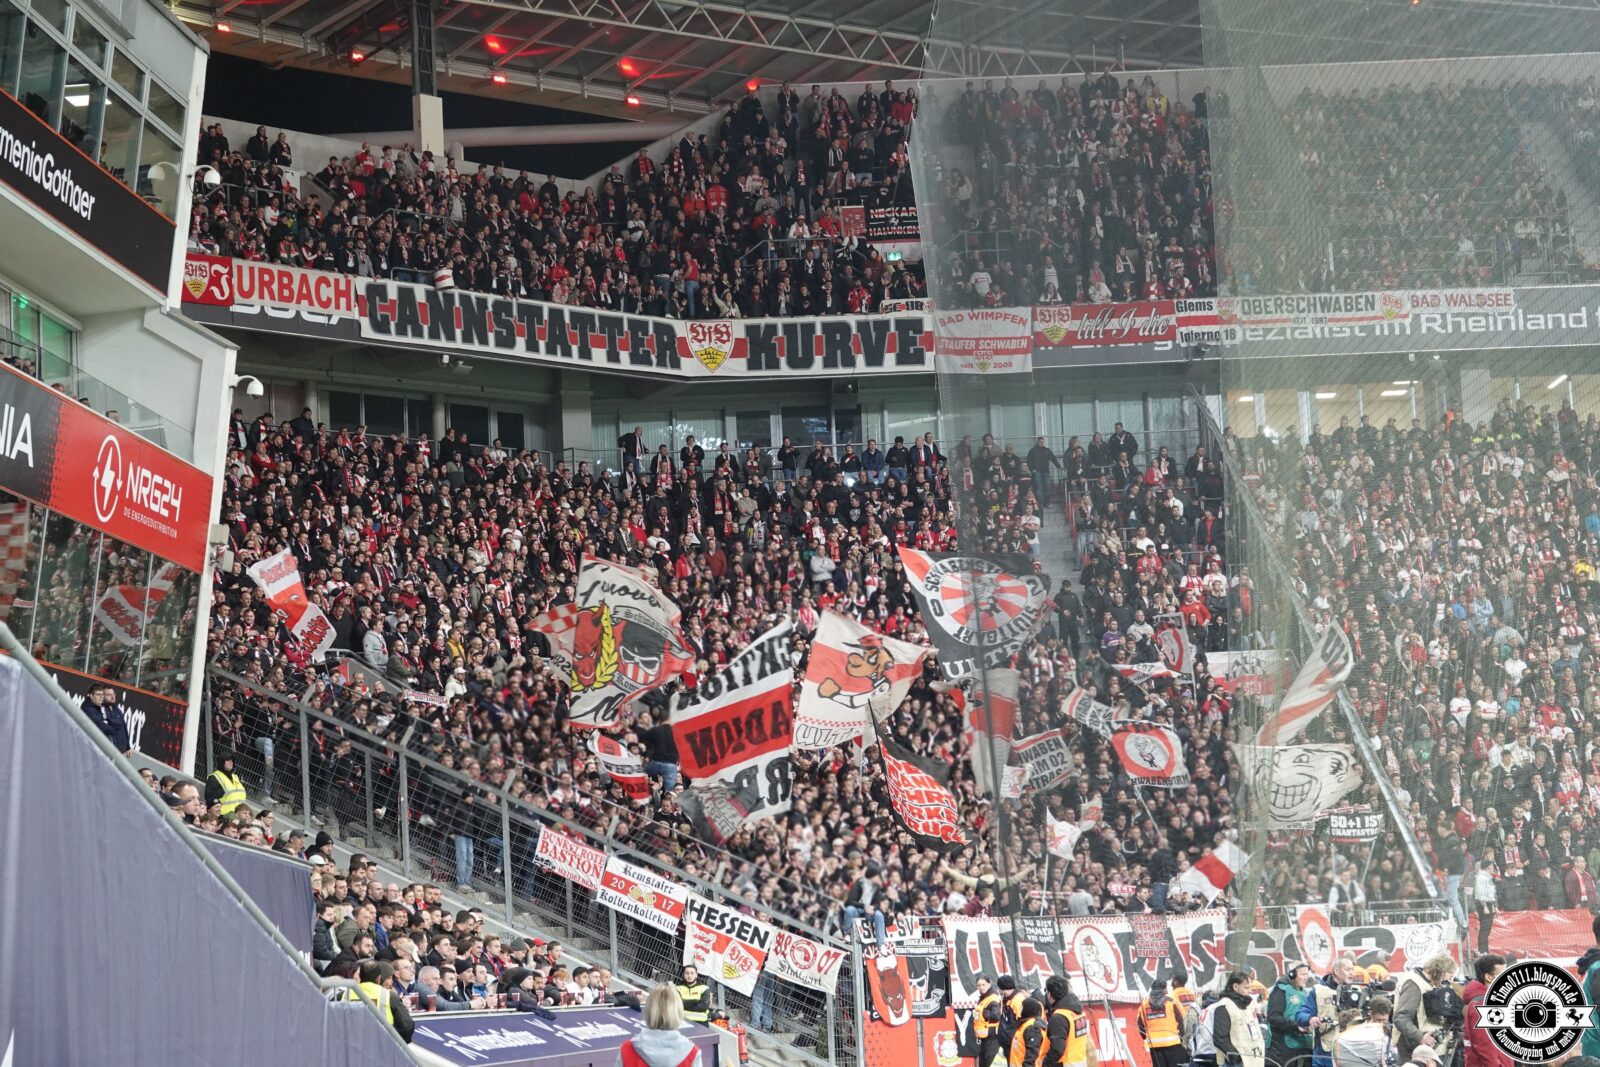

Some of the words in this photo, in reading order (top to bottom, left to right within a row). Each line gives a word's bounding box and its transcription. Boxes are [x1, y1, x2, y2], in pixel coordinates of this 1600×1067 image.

[0, 127, 95, 220] meniaGothaer
[870, 206, 918, 219] NECKAR
[237, 265, 353, 312] URBACH
[1410, 294, 1441, 309] BAD
[1444, 292, 1513, 308] WALDSEE
[938, 313, 964, 328] BAD
[967, 311, 1029, 328] WIMPFEN
[1175, 300, 1214, 313] Glems
[1241, 294, 1376, 316] OBERSCHWABEN
[1421, 306, 1588, 334] Rheinland
[364, 281, 682, 371] CANNSTATTER
[690, 322, 732, 346] VfB
[1077, 307, 1115, 340] till
[1139, 307, 1170, 337] die
[1180, 330, 1220, 343] Inferno
[1223, 328, 1237, 341] 18
[746, 318, 925, 371] KURVE
[940, 339, 976, 350] STAUFER
[978, 338, 1028, 350] SCHWABEN
[125, 461, 183, 523] NRG24
[1330, 814, 1362, 829] 50+1
[539, 839, 603, 880] BASTION
[543, 830, 605, 866] DUNKELROTE
[609, 876, 626, 890] 20
[660, 898, 676, 912] 17
[621, 863, 675, 895] Remstaler
[598, 887, 677, 932] Kolbenkollektiv
[688, 898, 770, 949] HESSEN
